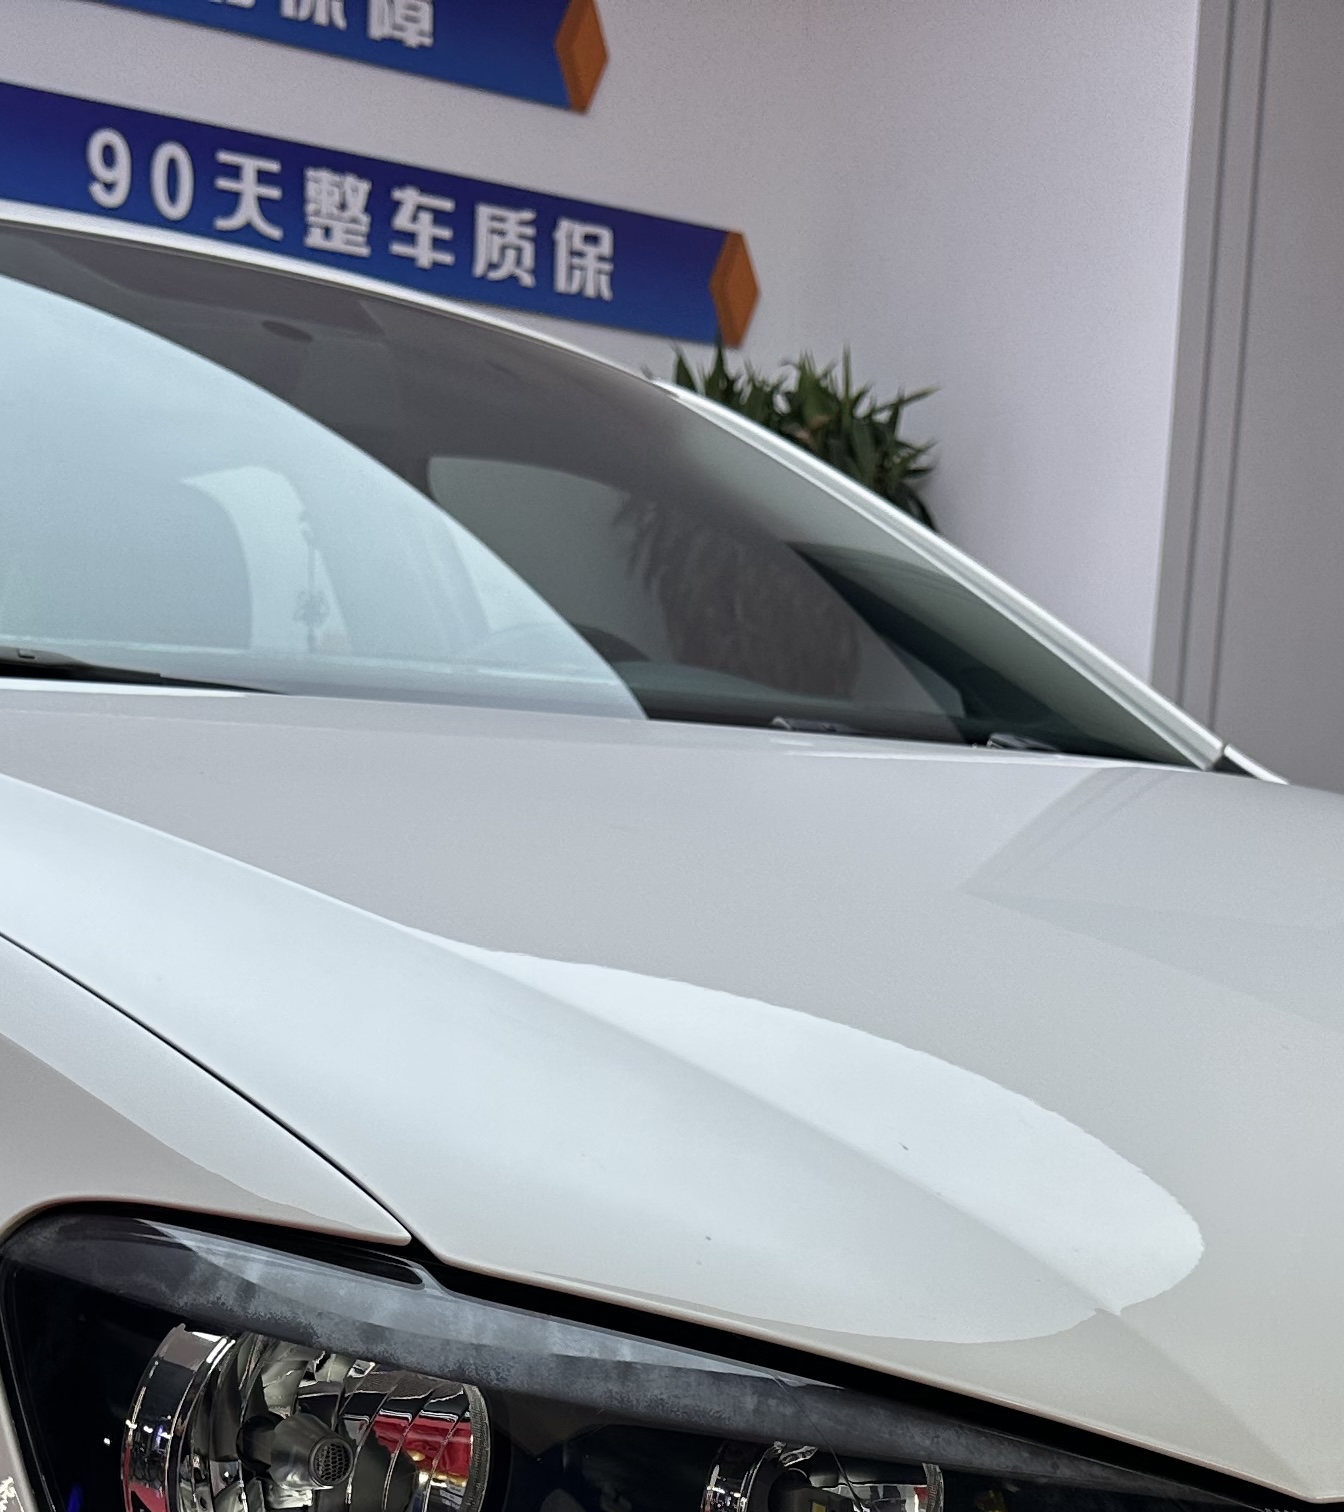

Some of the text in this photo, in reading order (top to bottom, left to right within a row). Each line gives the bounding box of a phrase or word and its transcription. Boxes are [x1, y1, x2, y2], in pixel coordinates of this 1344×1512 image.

[86, 127, 614, 301] 90天整车质保
